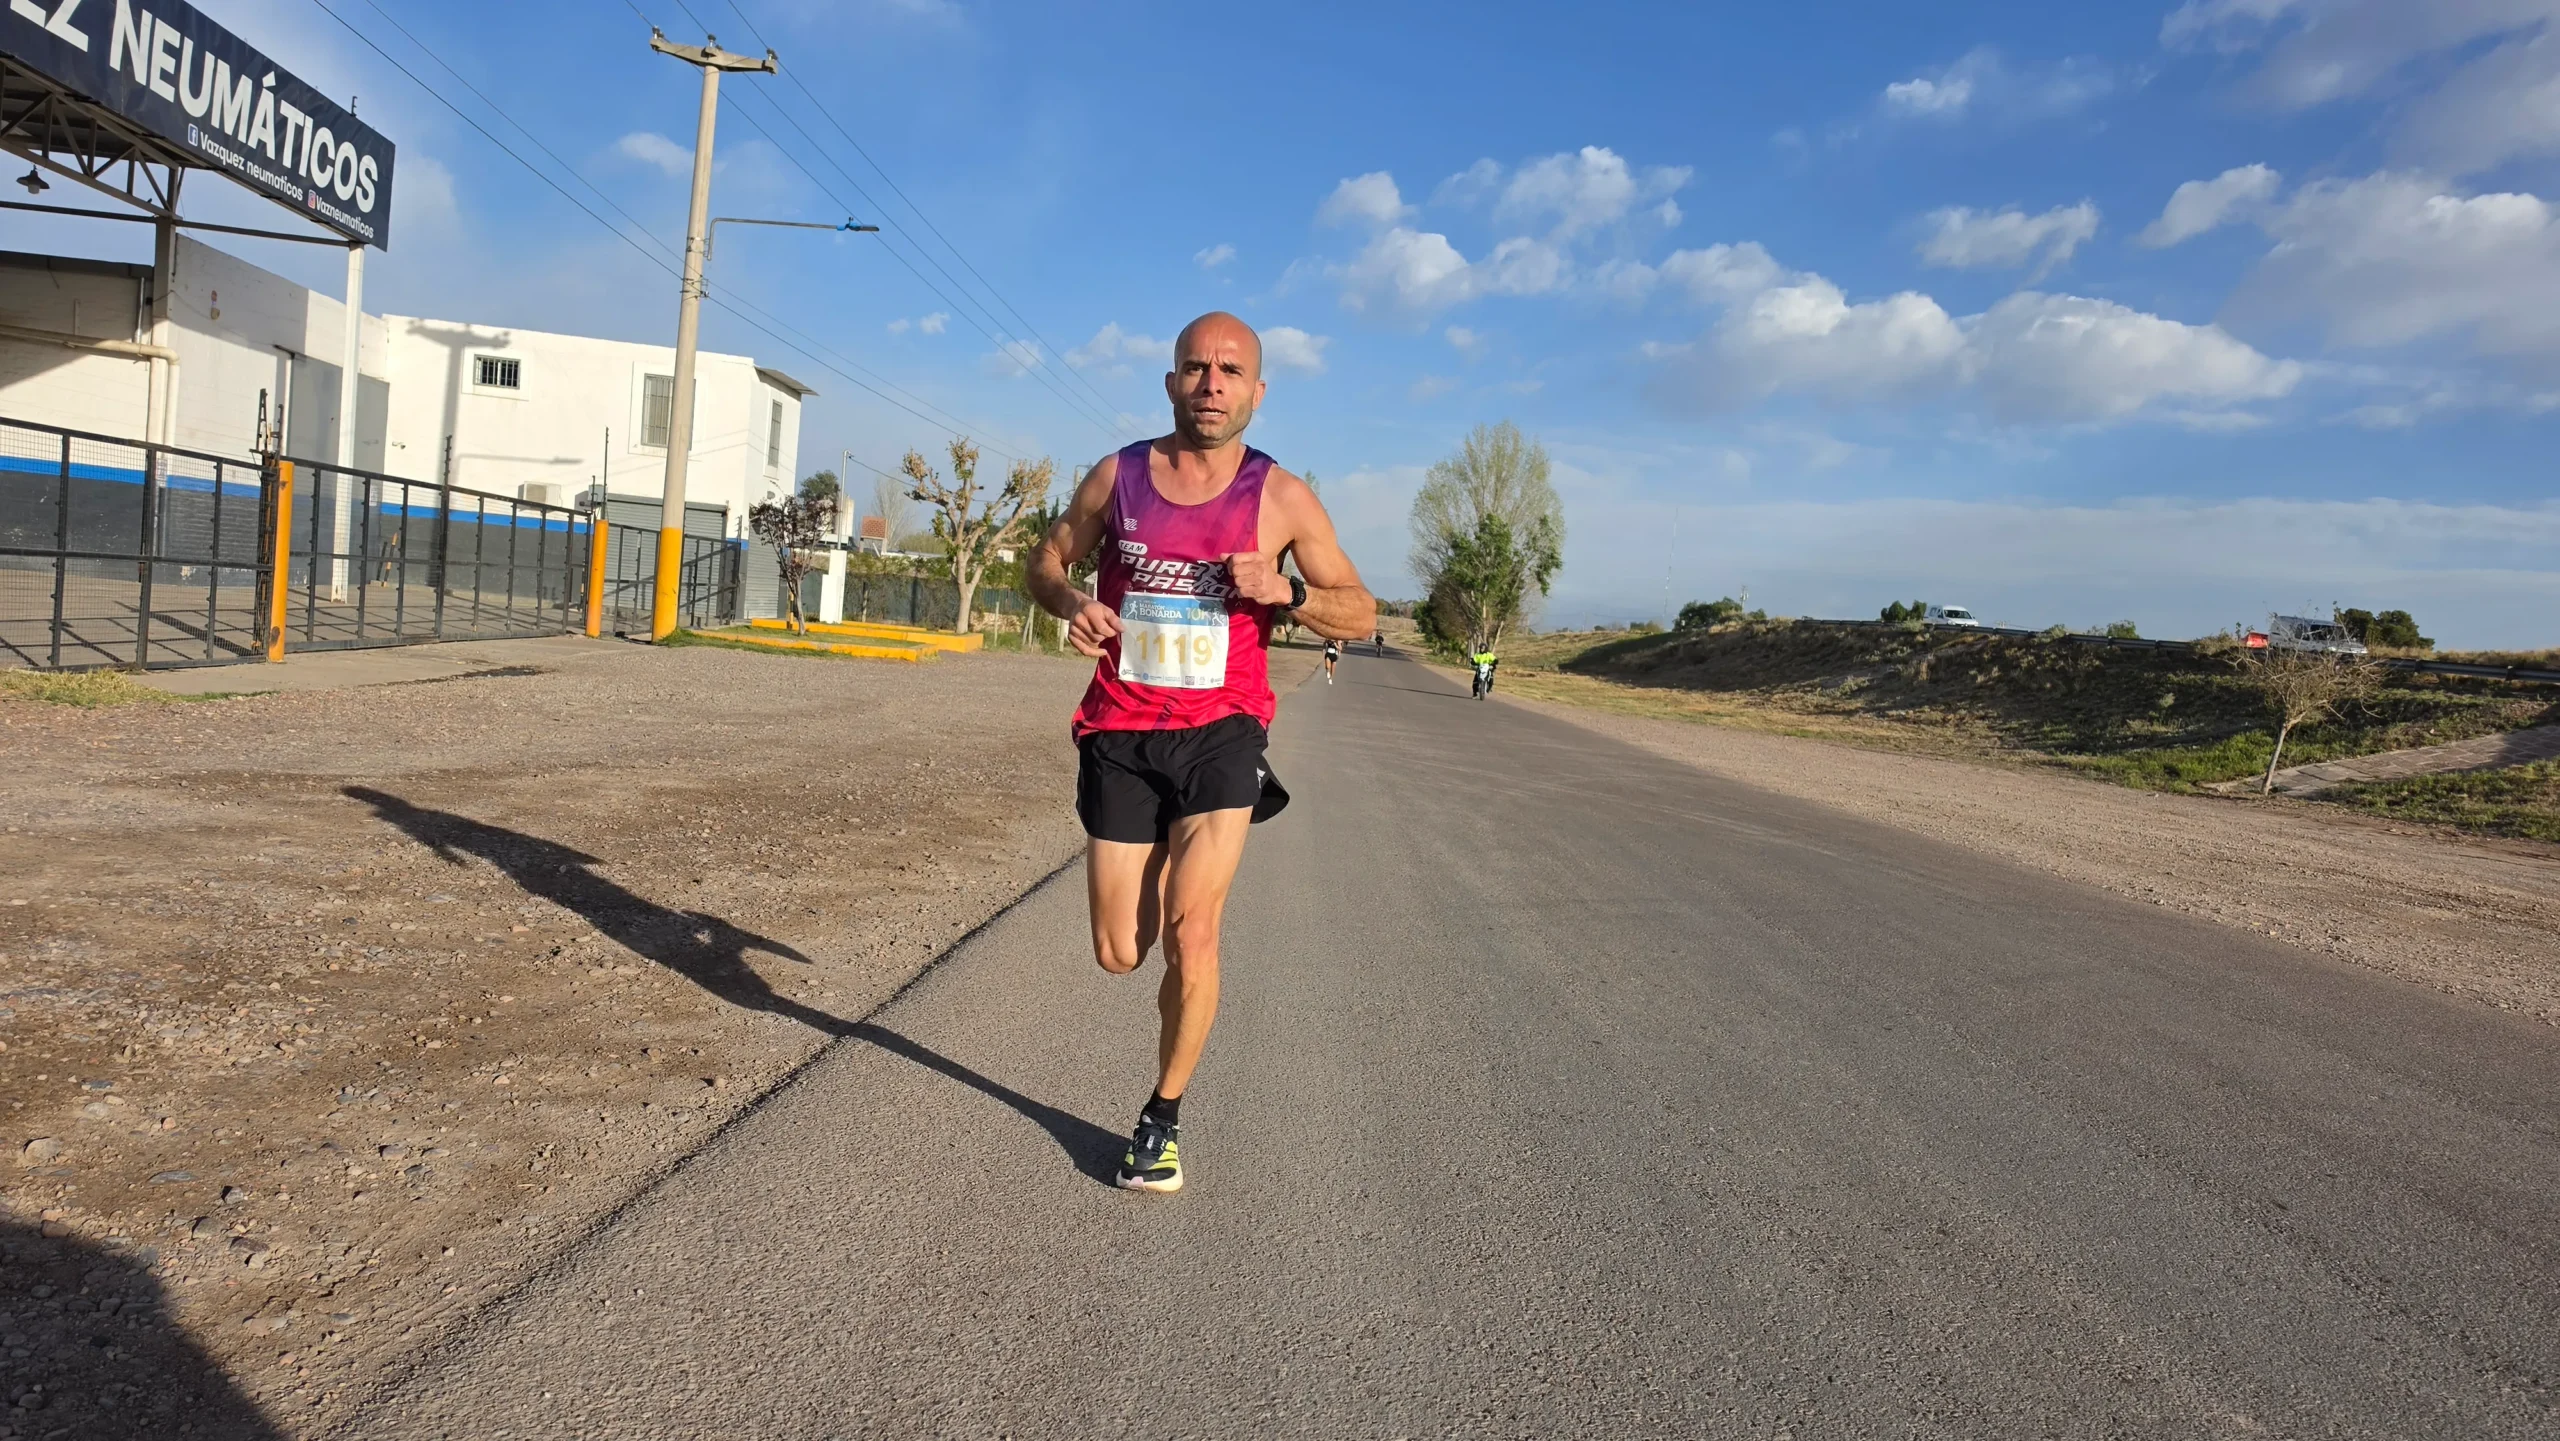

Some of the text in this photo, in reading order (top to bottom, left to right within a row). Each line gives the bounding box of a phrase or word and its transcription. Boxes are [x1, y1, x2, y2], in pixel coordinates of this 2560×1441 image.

[109, 0, 379, 213] NEUMÁTICOS
[200, 131, 245, 169] Vazquez
[246, 161, 304, 202] neumaticos
[316, 195, 375, 240] Vazneumaticos
[1119, 541, 1144, 553] TEAM
[1120, 553, 1204, 577] PURA
[1139, 607, 1183, 619] BONARDA
[1135, 631, 1213, 666] 1119
